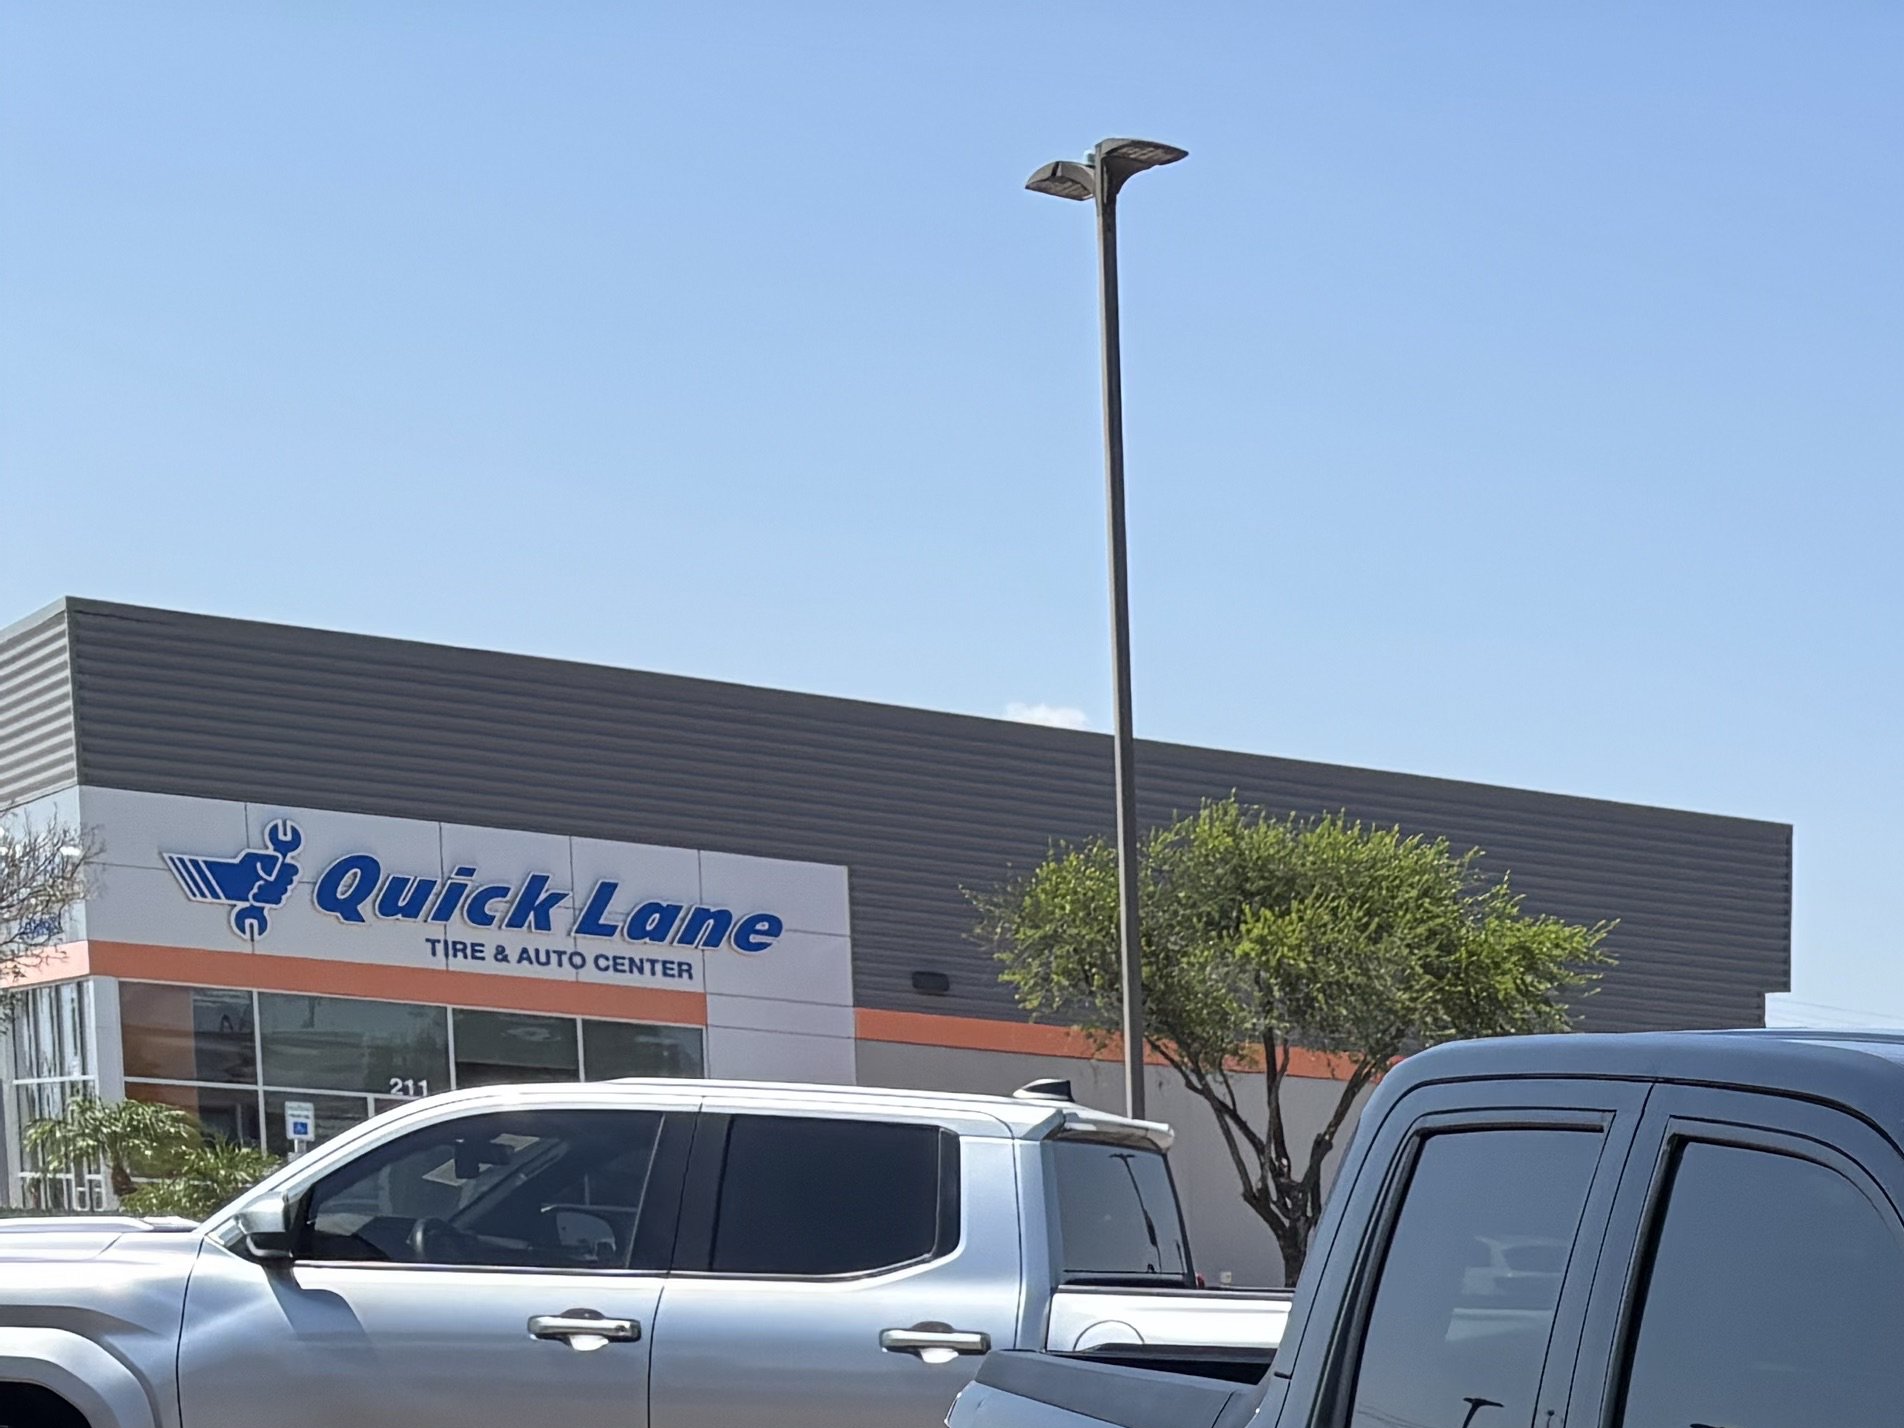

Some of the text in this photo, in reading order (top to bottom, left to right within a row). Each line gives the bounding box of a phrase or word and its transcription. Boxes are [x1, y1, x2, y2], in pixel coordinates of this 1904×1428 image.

[315, 853, 785, 955] Quick Lane
[425, 938, 694, 981] TIRE & AUTO CENTER
[389, 1077, 428, 1097] 211
